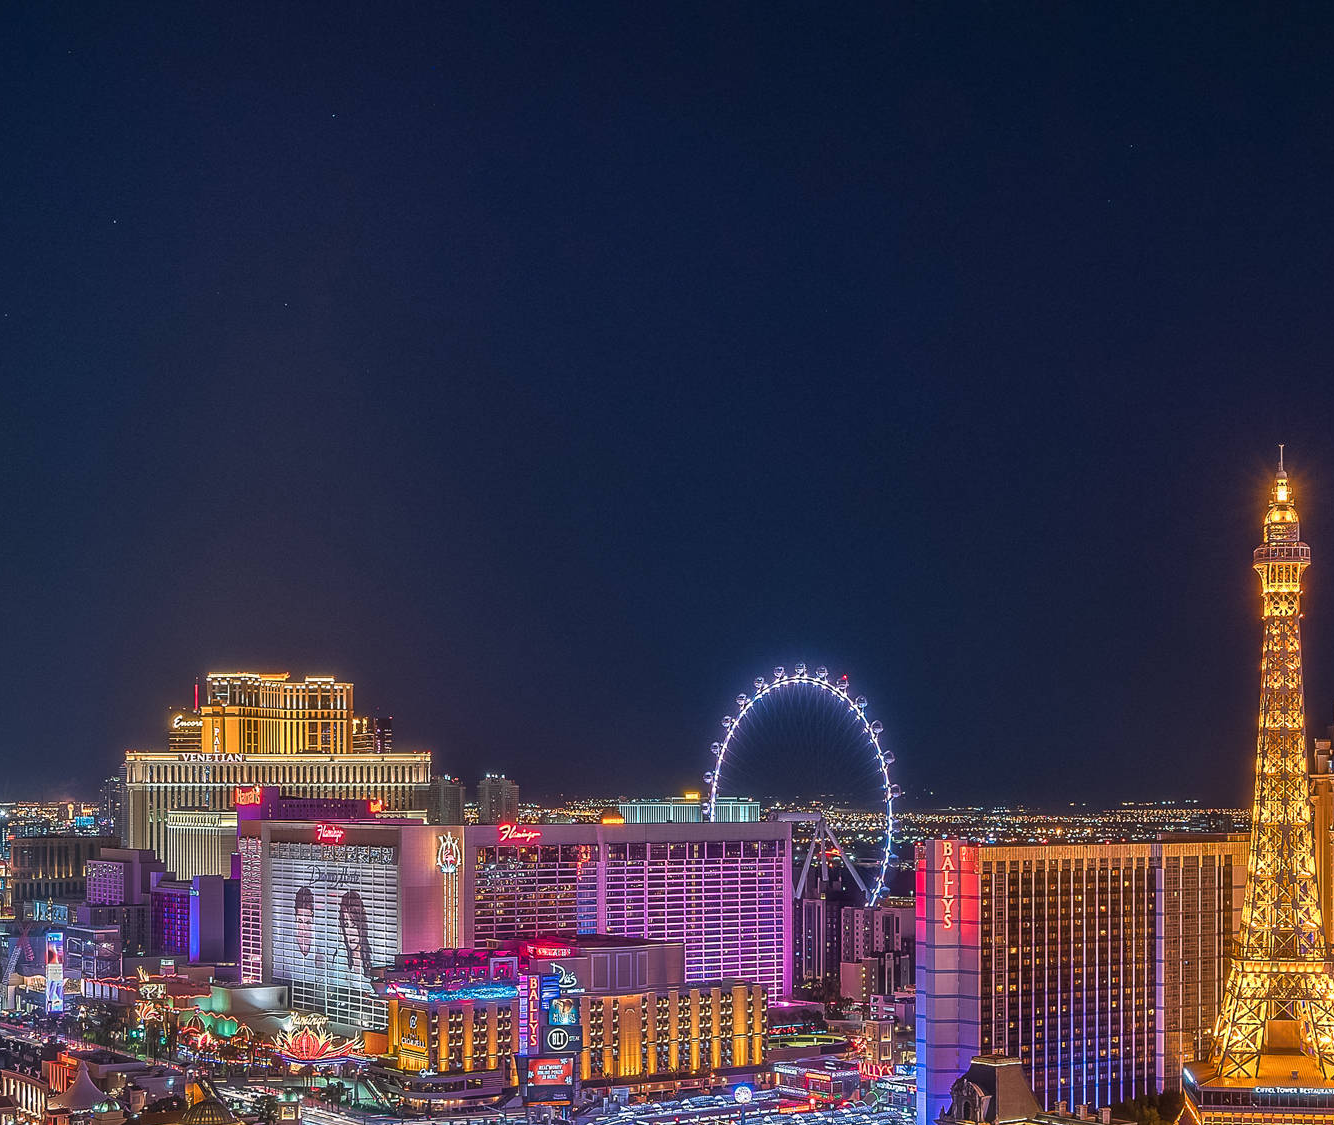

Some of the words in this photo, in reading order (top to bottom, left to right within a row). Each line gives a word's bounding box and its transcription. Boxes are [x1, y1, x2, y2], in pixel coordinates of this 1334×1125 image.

[173, 715, 203, 728] Encore
[181, 753, 243, 762] VENETIAN
[317, 824, 344, 842] Flamingo
[498, 824, 541, 842] Flamingo
[552, 1033, 564, 1045] BLT
